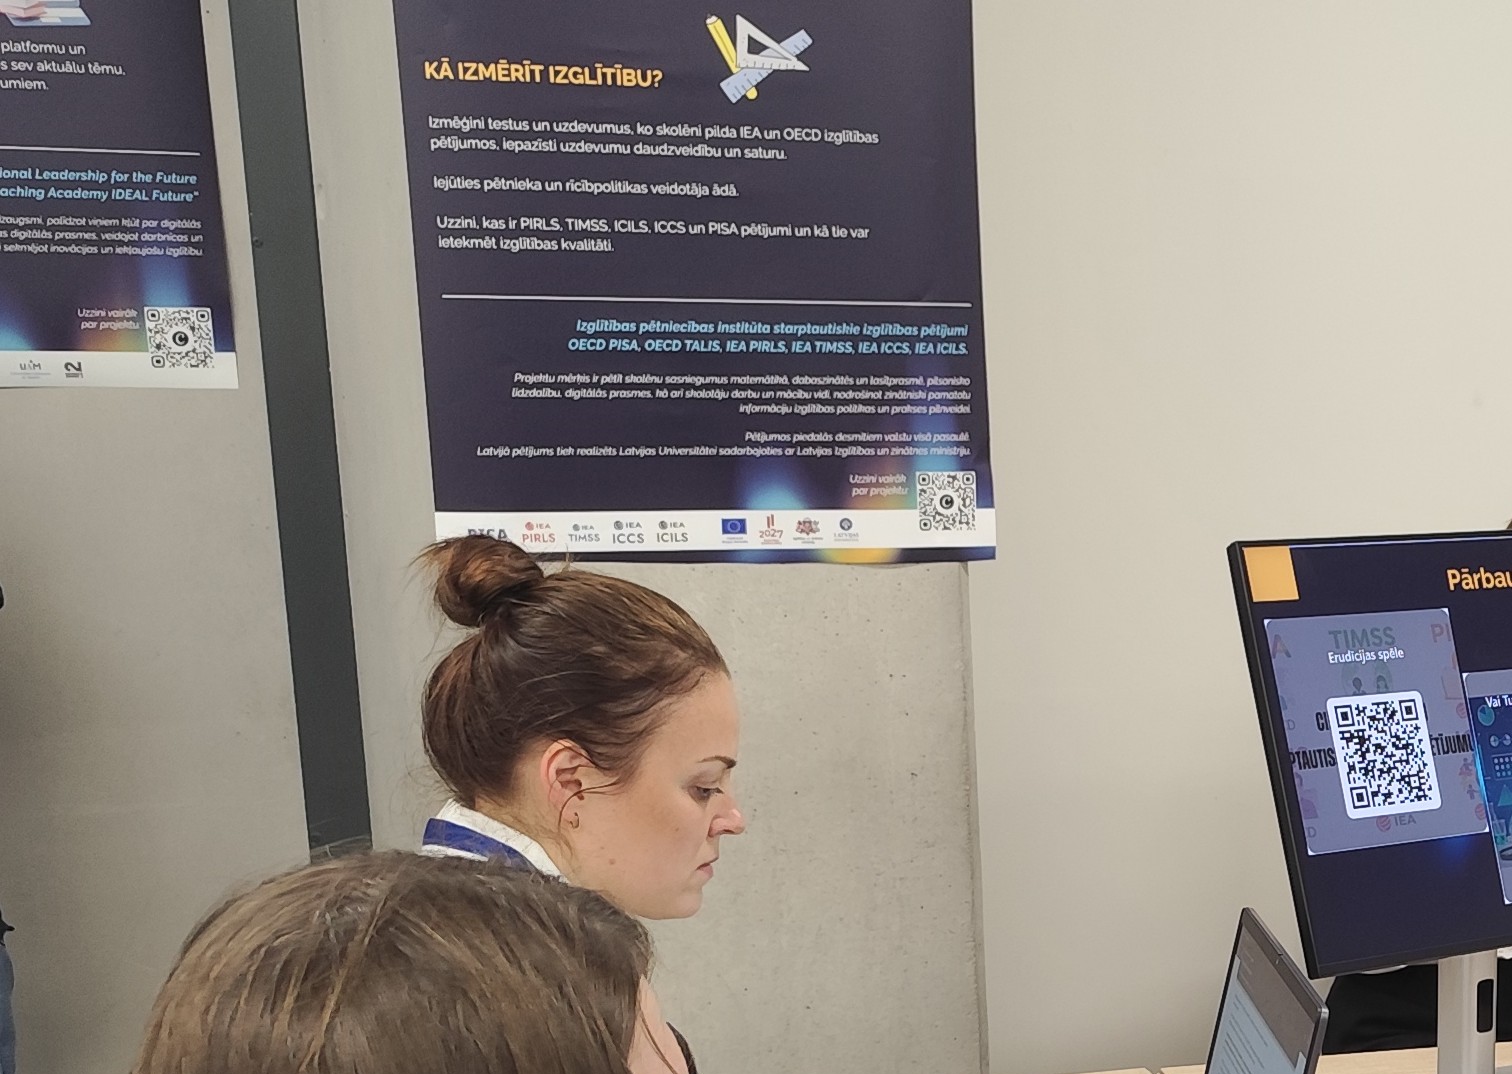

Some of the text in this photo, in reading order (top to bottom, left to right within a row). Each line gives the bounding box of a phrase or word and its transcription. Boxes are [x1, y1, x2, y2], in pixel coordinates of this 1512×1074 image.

[68, 45, 86, 55] un
[10, 61, 33, 72] sev
[36, 60, 85, 74] aktuālu
[88, 61, 126, 76] tēmu.
[424, 57, 664, 88] KĀ IZMĒRĪT IZGLĪTĪBU?
[428, 115, 880, 146] Izmēģini testus un uzdevumus, ko skolēni pilda IEA un OECD izglītības
[430, 136, 788, 160] pētījumos, iepazīsti uzdevumu daudzveidību un saturu.
[35, 168, 108, 183] Leadership
[110, 169, 130, 185] for
[132, 170, 153, 183] the
[155, 171, 197, 185] Future
[46, 186, 109, 203] Academy
[111, 189, 150, 201] IDEAL
[432, 175, 740, 198] Iejūties pētnieka un rīcībpolitikas veidotāja ādā.
[436, 215, 870, 239] Uzzini, kas ir PIRLS, TIMSS, ICILS, ICCS un PISA pētījumi un kā tie var
[438, 234, 615, 253] ietekmēt izglītības kvalitāti.
[576, 319, 969, 339] Izglītības pētniecības institūta starptautiskie izglītības pētījumi
[567, 338, 969, 356] OECD PISA, OECD TALIS, IEA PIRLS, IEA TIMSS, IEA ICCS, IEA ICILS.
[535, 522, 551, 530] IEA
[625, 521, 642, 529] IEA
[669, 521, 686, 529] IEA
[759, 527, 784, 539] 2027
[522, 532, 556, 544] PIRLS
[568, 533, 601, 543] TIMSS
[612, 532, 645, 544] ICCS
[656, 531, 689, 543] ICILS
[1328, 625, 1396, 650] TIMSS
[1328, 646, 1405, 665] Erudīcijas spēle
[1484, 695, 1501, 708] Vai
